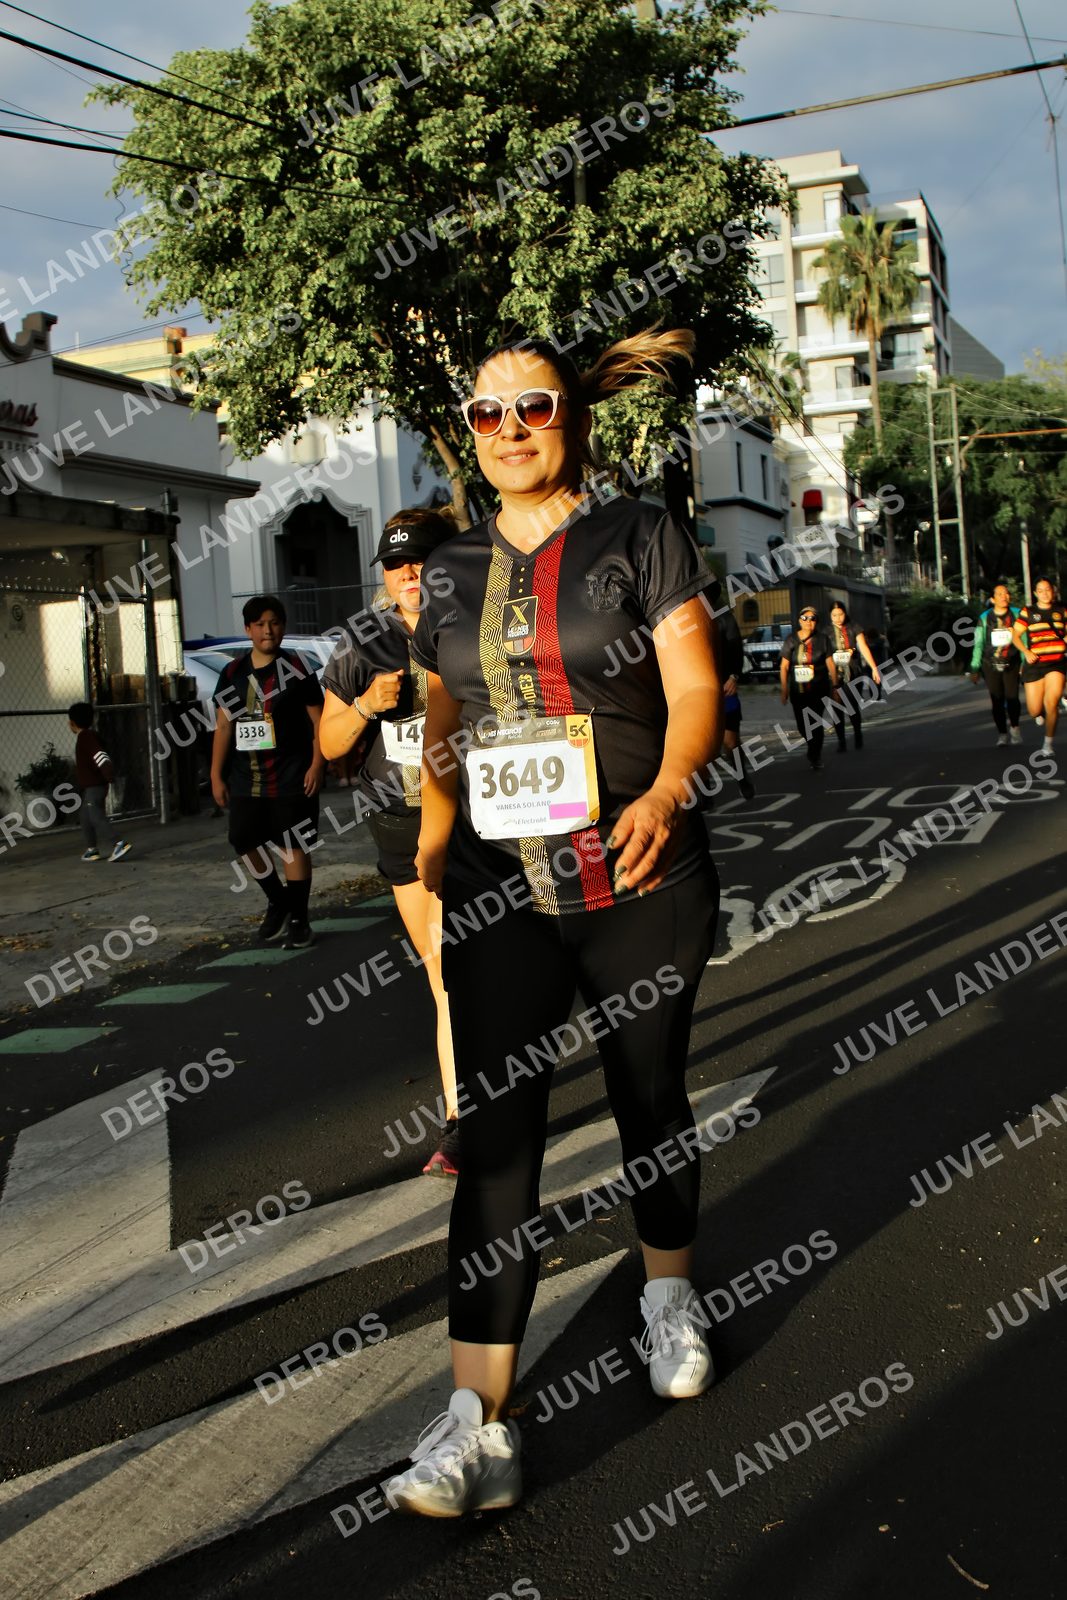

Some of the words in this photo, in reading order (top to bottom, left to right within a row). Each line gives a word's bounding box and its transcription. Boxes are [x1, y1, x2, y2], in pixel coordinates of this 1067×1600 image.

[390, 529, 408, 543] alo
[393, 721, 425, 743] 14
[569, 724, 588, 738] 5K
[479, 755, 565, 799] 3649
[496, 802, 521, 811] VANESA
[709, 811, 1005, 854] BUS
